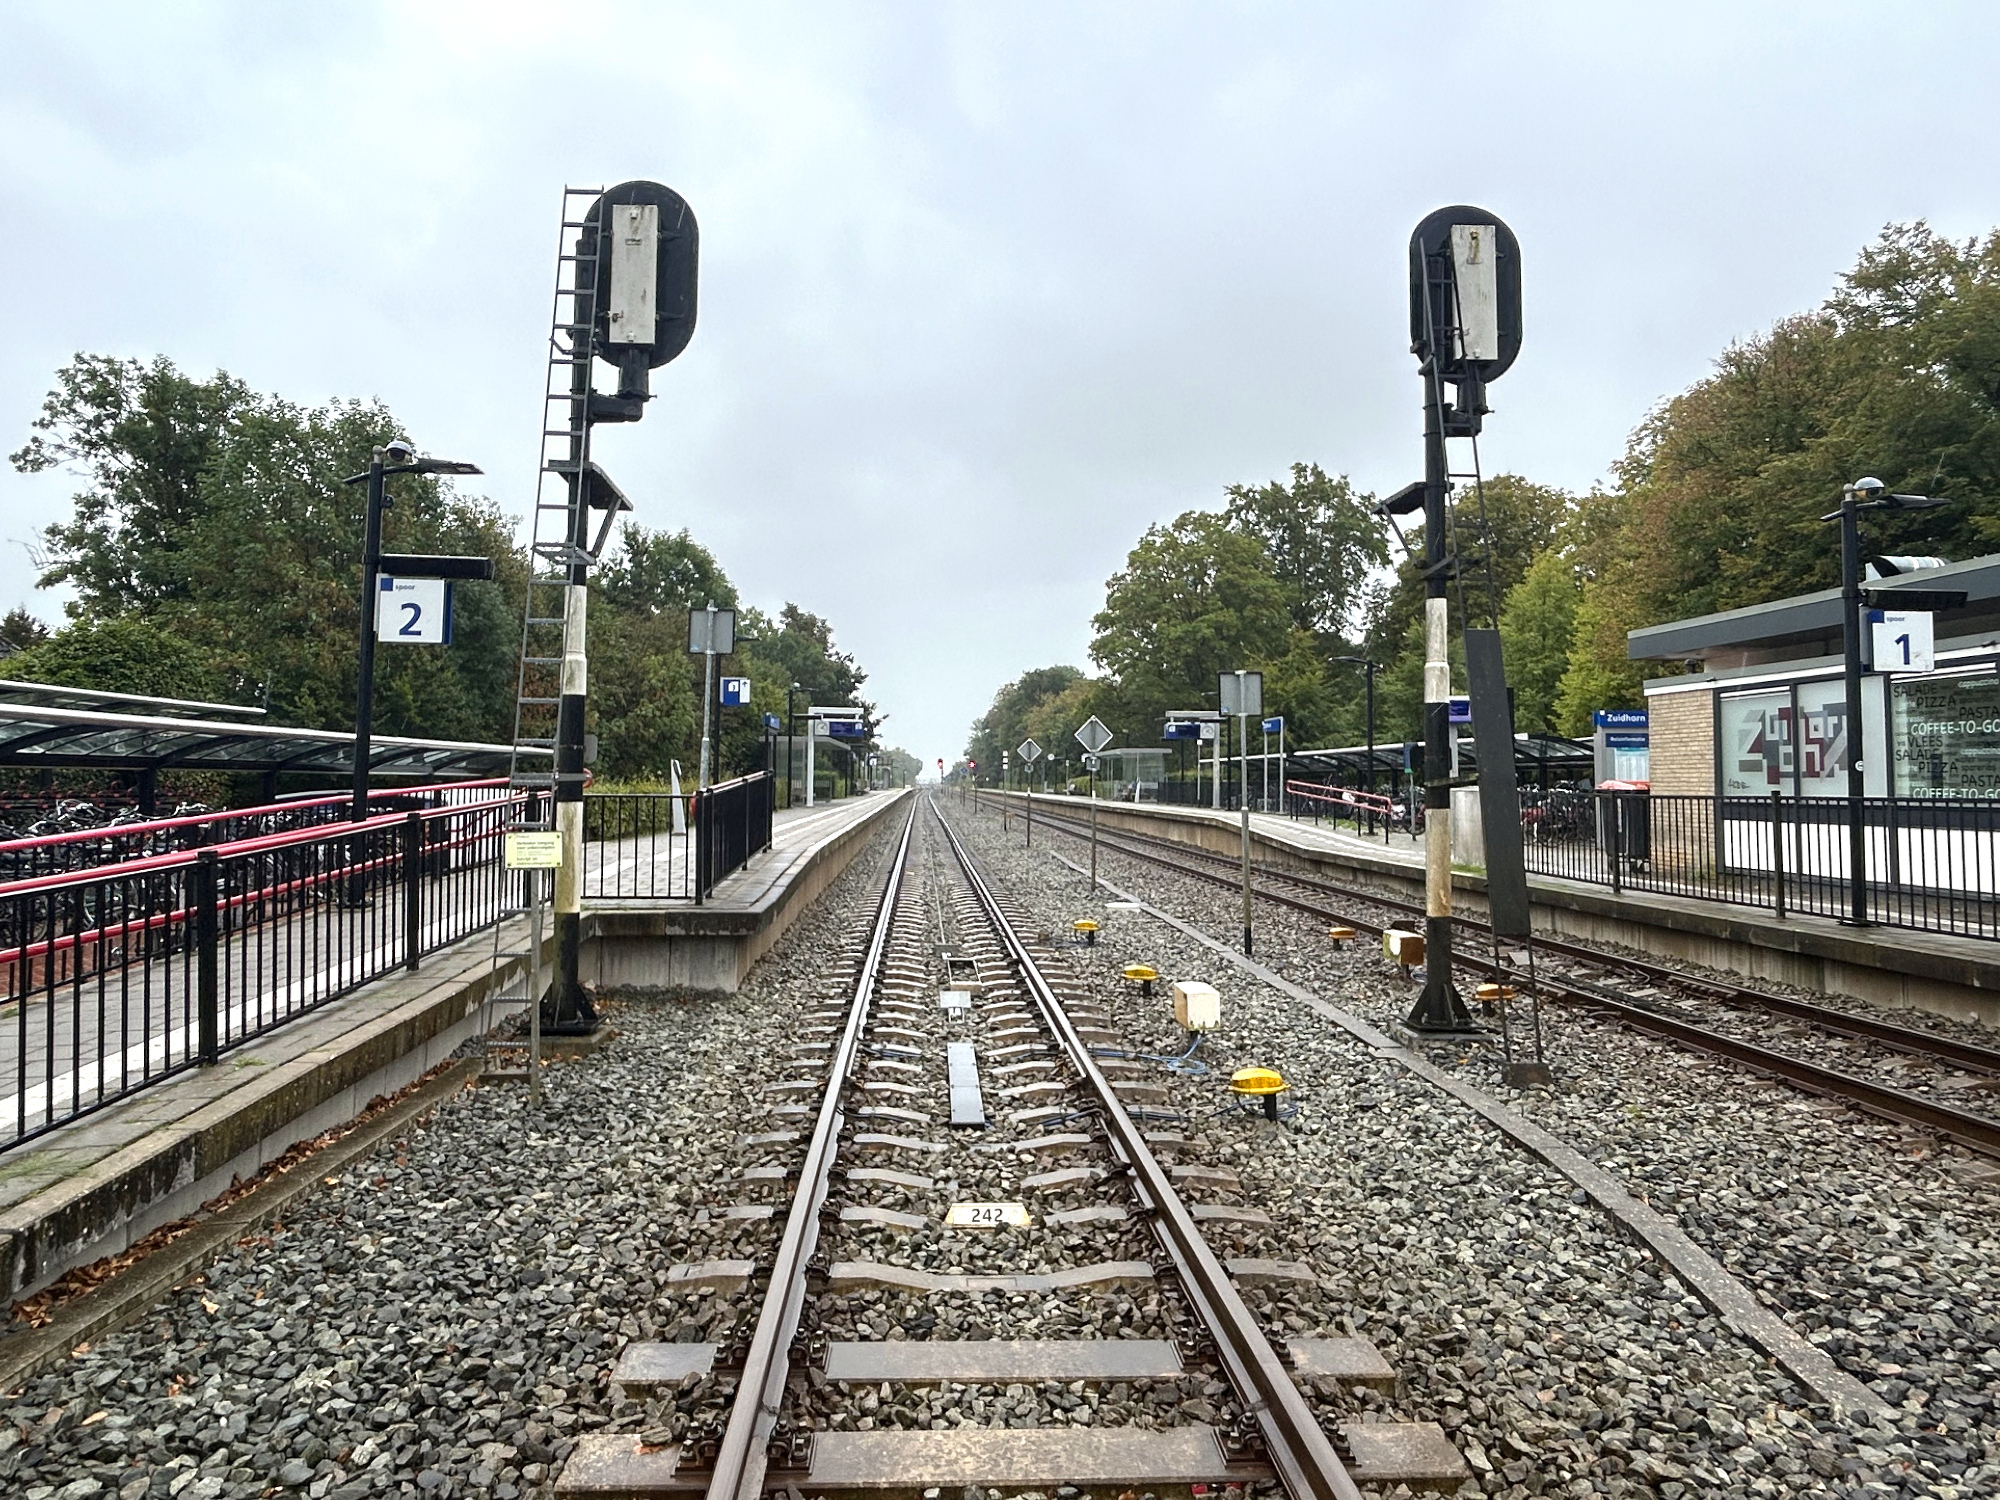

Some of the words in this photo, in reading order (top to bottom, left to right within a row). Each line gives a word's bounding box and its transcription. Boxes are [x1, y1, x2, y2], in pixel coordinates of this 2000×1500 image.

[399, 602, 421, 636] 2
[1894, 633, 1910, 665] 1
[1893, 683, 1938, 698] SALADE
[1916, 695, 1956, 709] PIZZA
[1607, 713, 1646, 722] Zuidhorn
[1959, 706, 2000, 719] PASTA
[1908, 736, 1943, 747] VLEES
[1895, 748, 1941, 761] SALADE
[1918, 761, 1959, 773] PIZZA
[1961, 774, 2000, 787] PASTA
[972, 1208, 1003, 1222] 242
